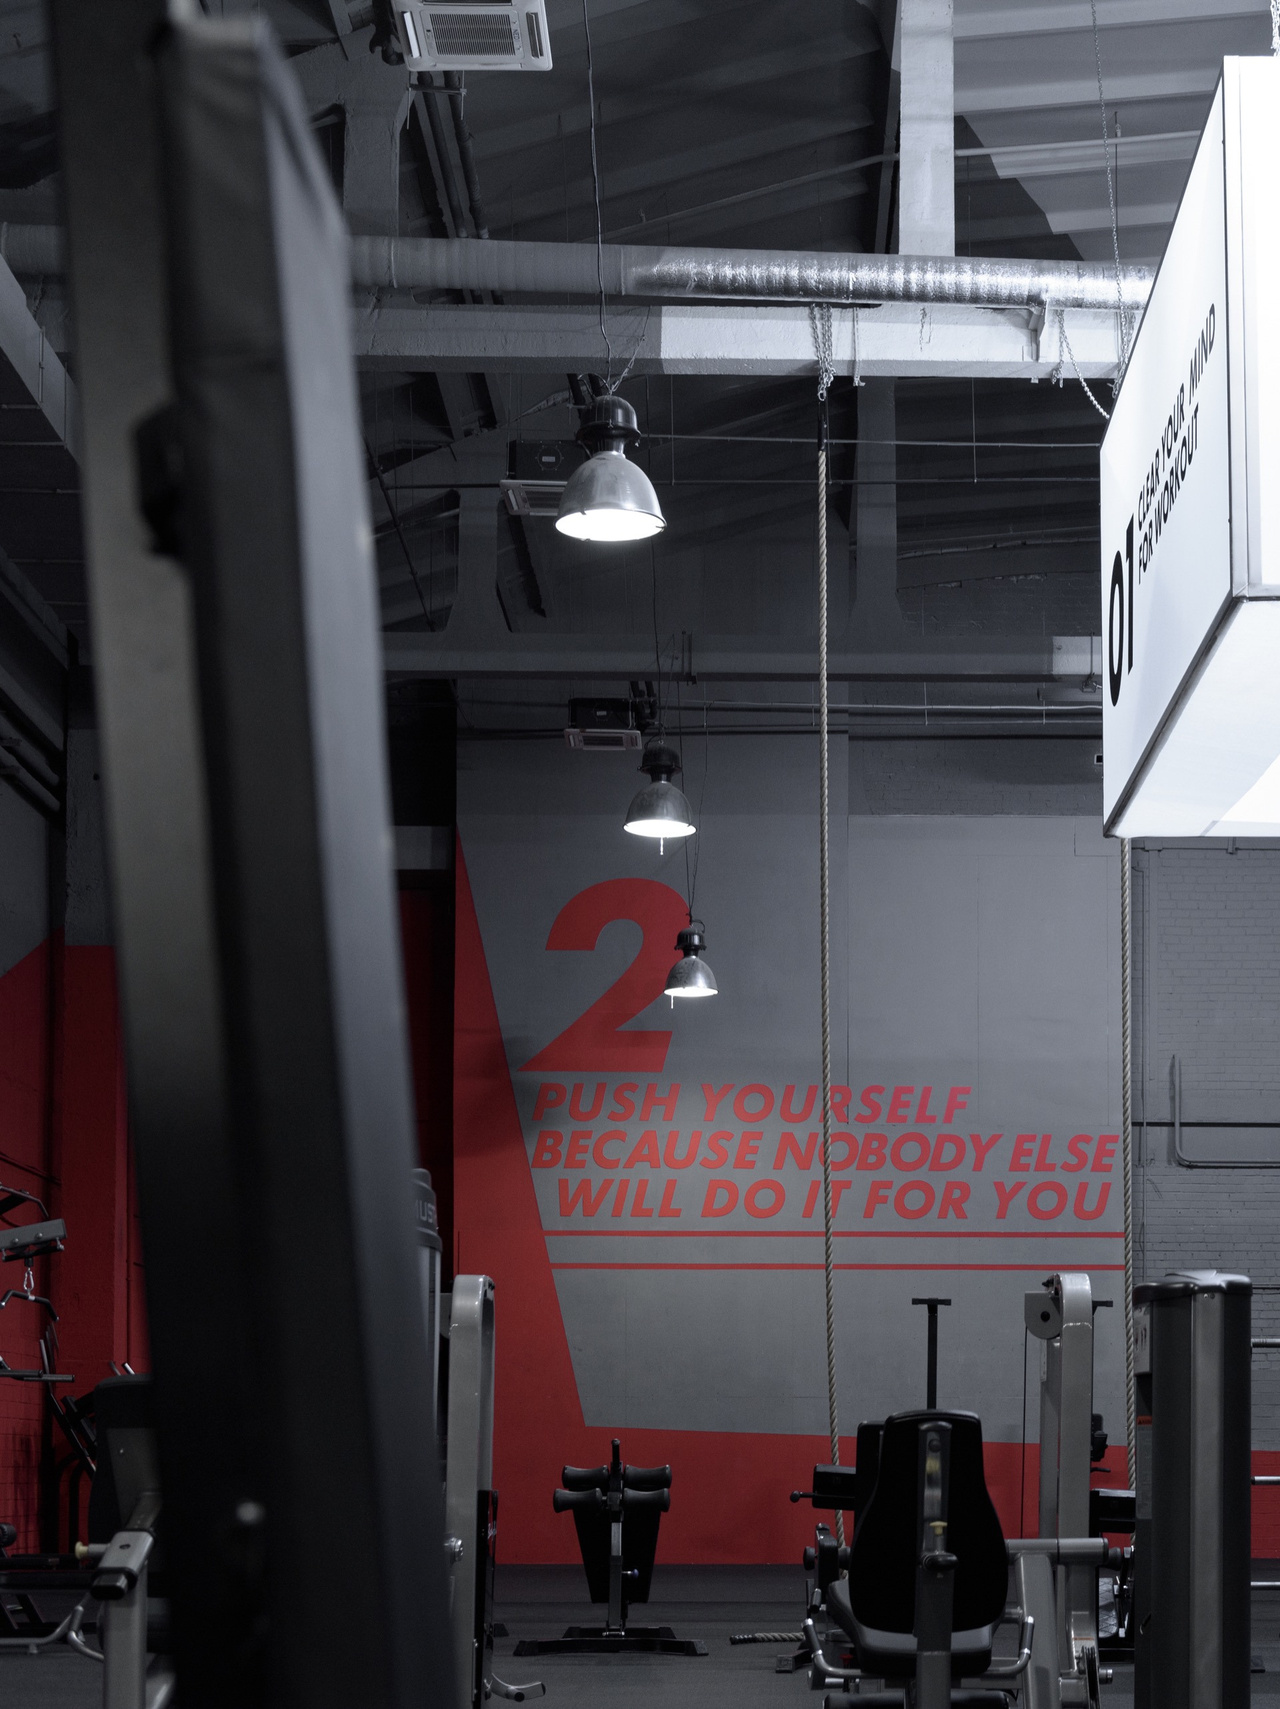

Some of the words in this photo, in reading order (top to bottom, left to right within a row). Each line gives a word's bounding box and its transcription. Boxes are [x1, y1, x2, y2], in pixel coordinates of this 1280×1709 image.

[1138, 448, 1161, 531] CLEAR
[1161, 382, 1185, 473] YOUR
[1189, 303, 1216, 406] MIND
[1138, 519, 1154, 585] FOR
[1154, 402, 1199, 545] WORKOUT
[1109, 513, 1135, 707] 01
[519, 877, 692, 1073] 2
[530, 1129, 764, 1170] BECAUSE
[773, 1131, 1004, 1172] NOBODY
[1009, 1133, 1120, 1173] ELSE
[532, 1082, 682, 1123] PUSH
[701, 1083, 973, 1125] YOURSELF
[558, 1178, 682, 1218] WILL
[700, 1178, 786, 1219] DO
[801, 1179, 853, 1219] IT
[863, 1179, 972, 1220] FOR
[993, 1180, 1113, 1221] YOU
